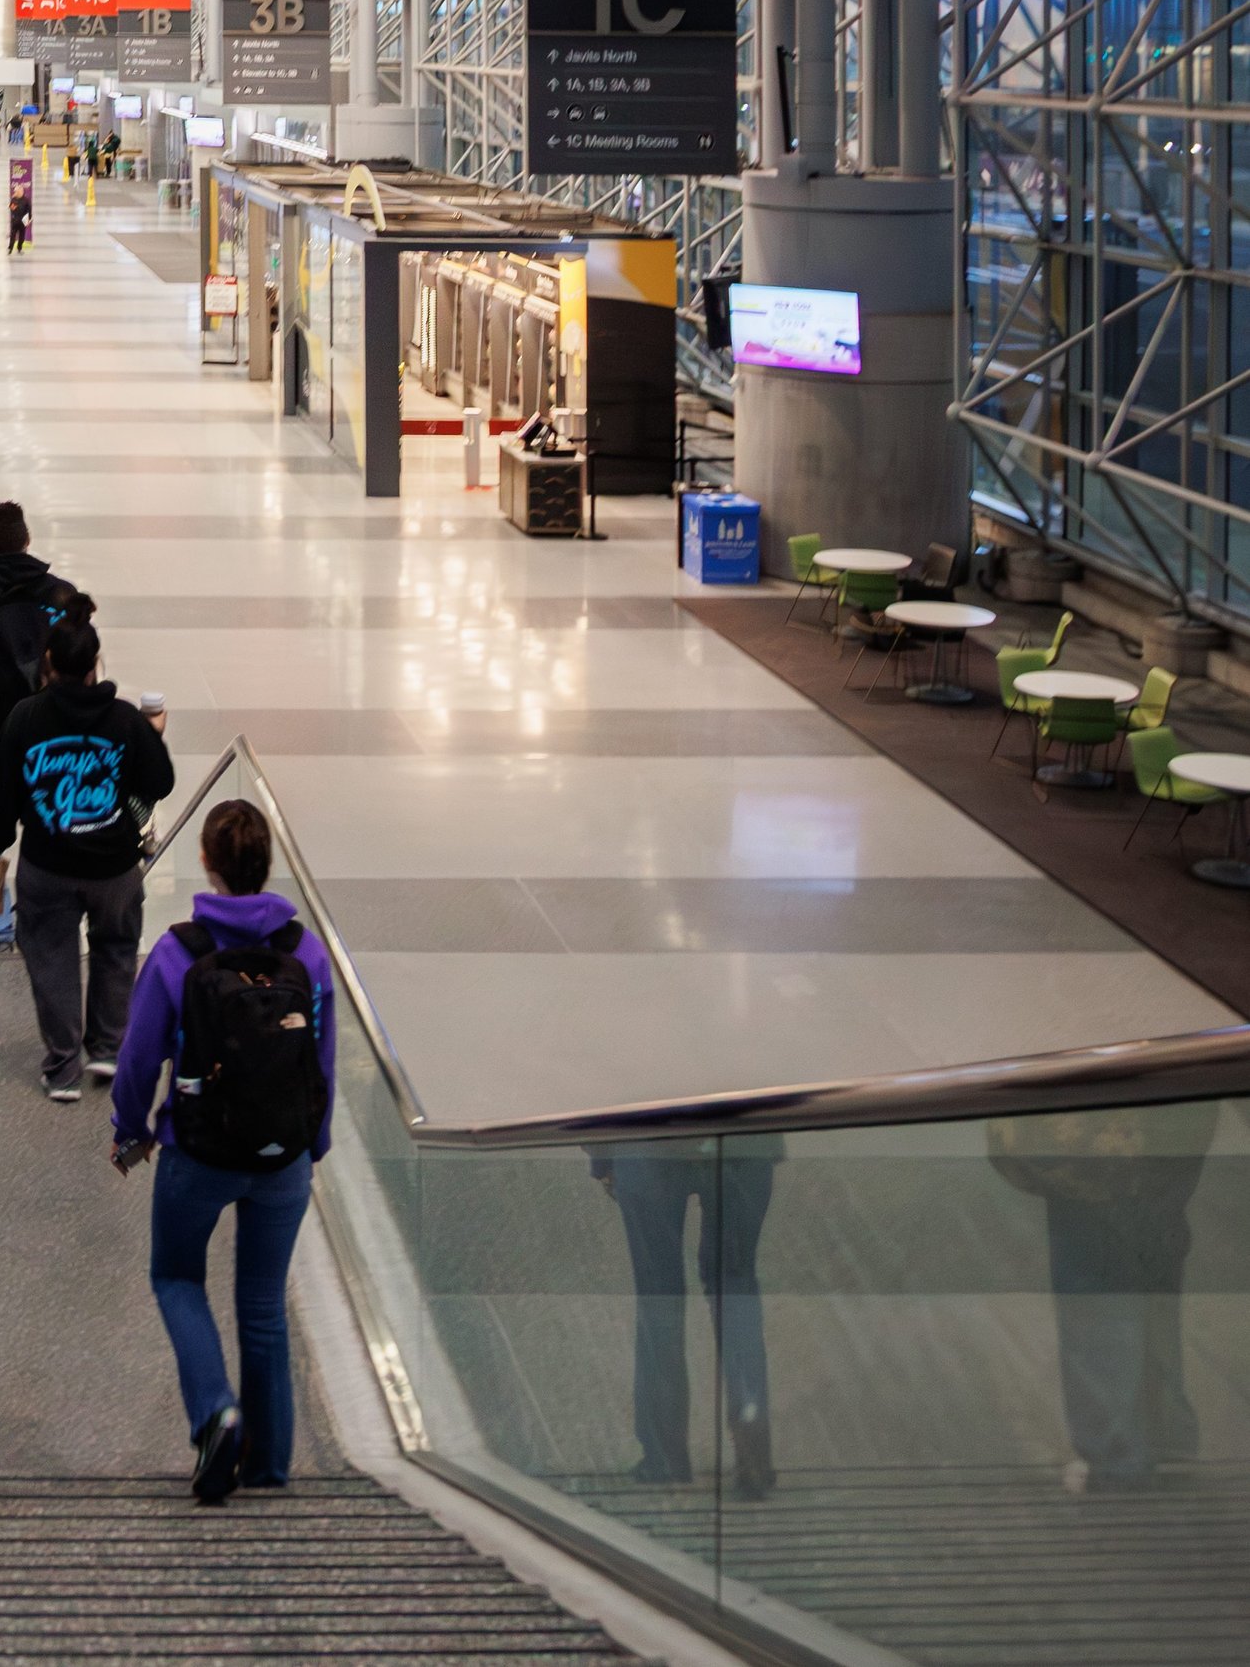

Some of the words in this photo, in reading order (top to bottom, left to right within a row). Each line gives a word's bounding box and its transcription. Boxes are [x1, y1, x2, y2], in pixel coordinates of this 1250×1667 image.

[78, 15, 107, 35] 3A
[137, 9, 173, 35] 1B
[602, 49, 638, 64] North
[585, 135, 634, 150] Meeting
[636, 135, 679, 149] Rooms
